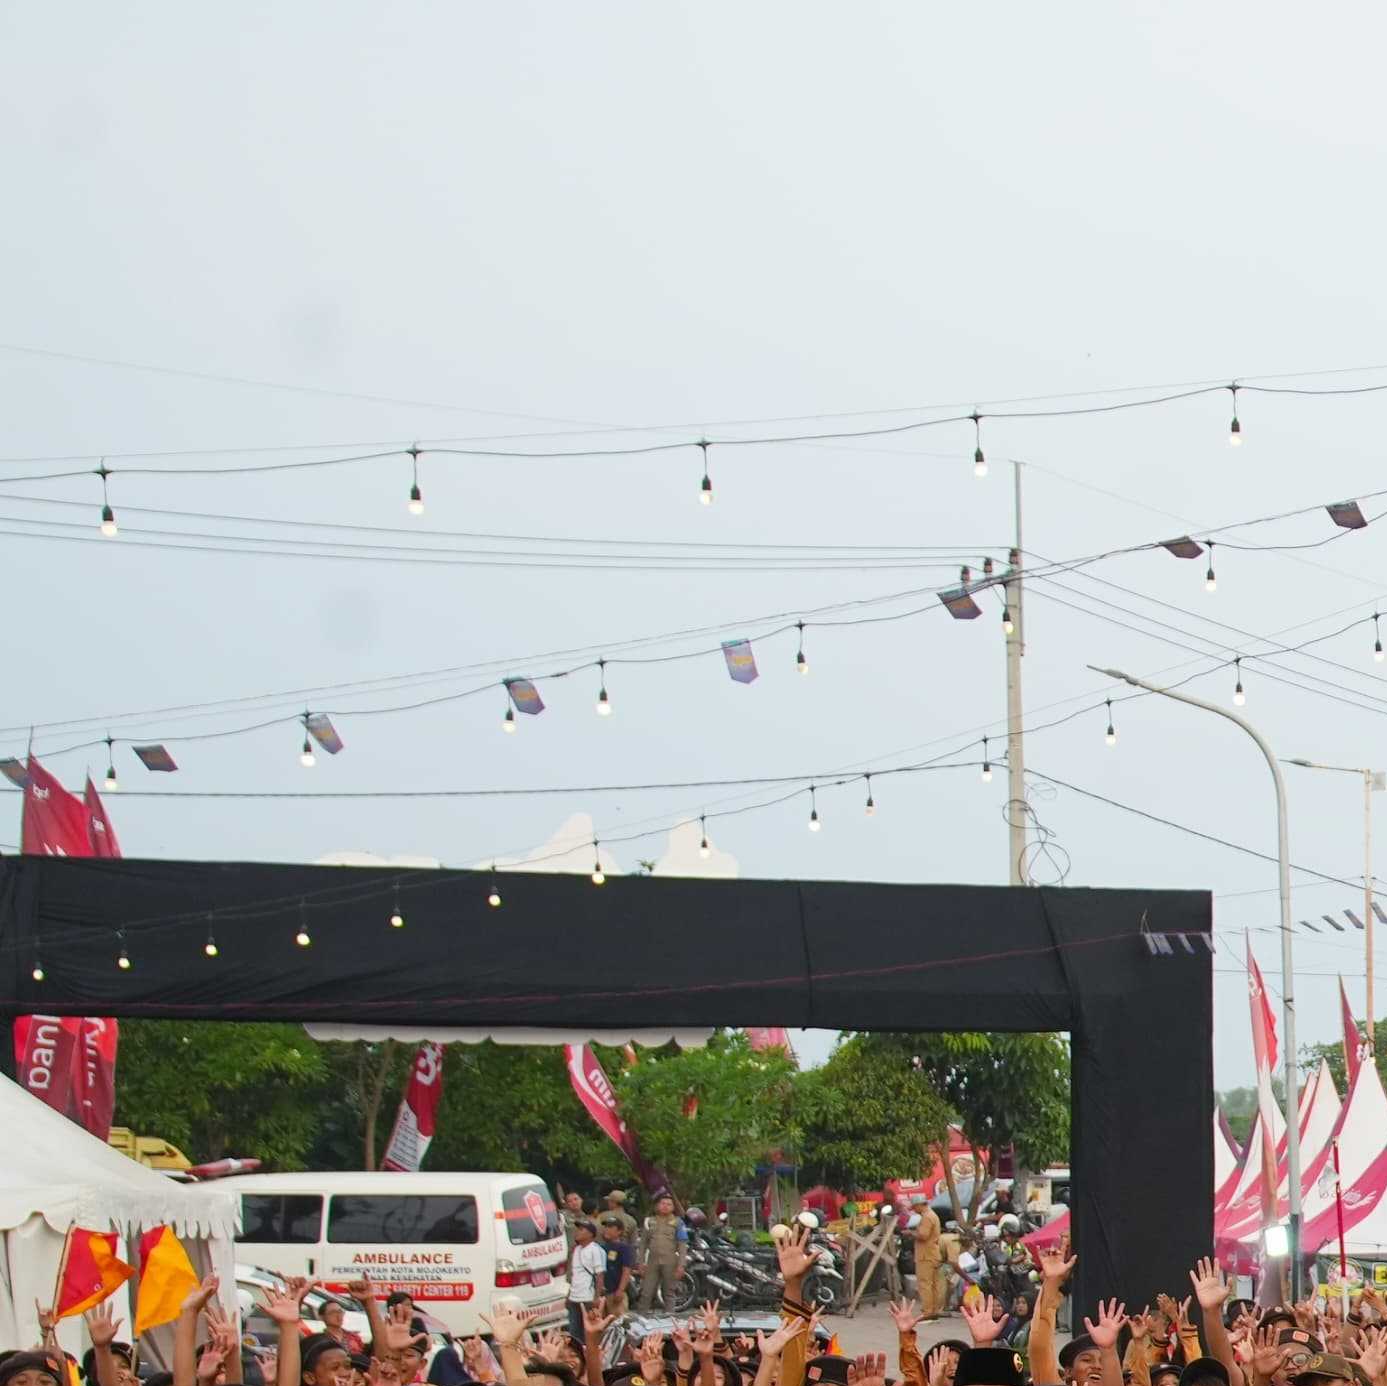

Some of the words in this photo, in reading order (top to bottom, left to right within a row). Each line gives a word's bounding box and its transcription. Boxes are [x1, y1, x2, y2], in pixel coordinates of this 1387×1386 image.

[521, 1242, 563, 1259] AMBULANCE
[352, 1253, 455, 1264] AMBULANCE
[391, 1266, 413, 1274] KOTA
